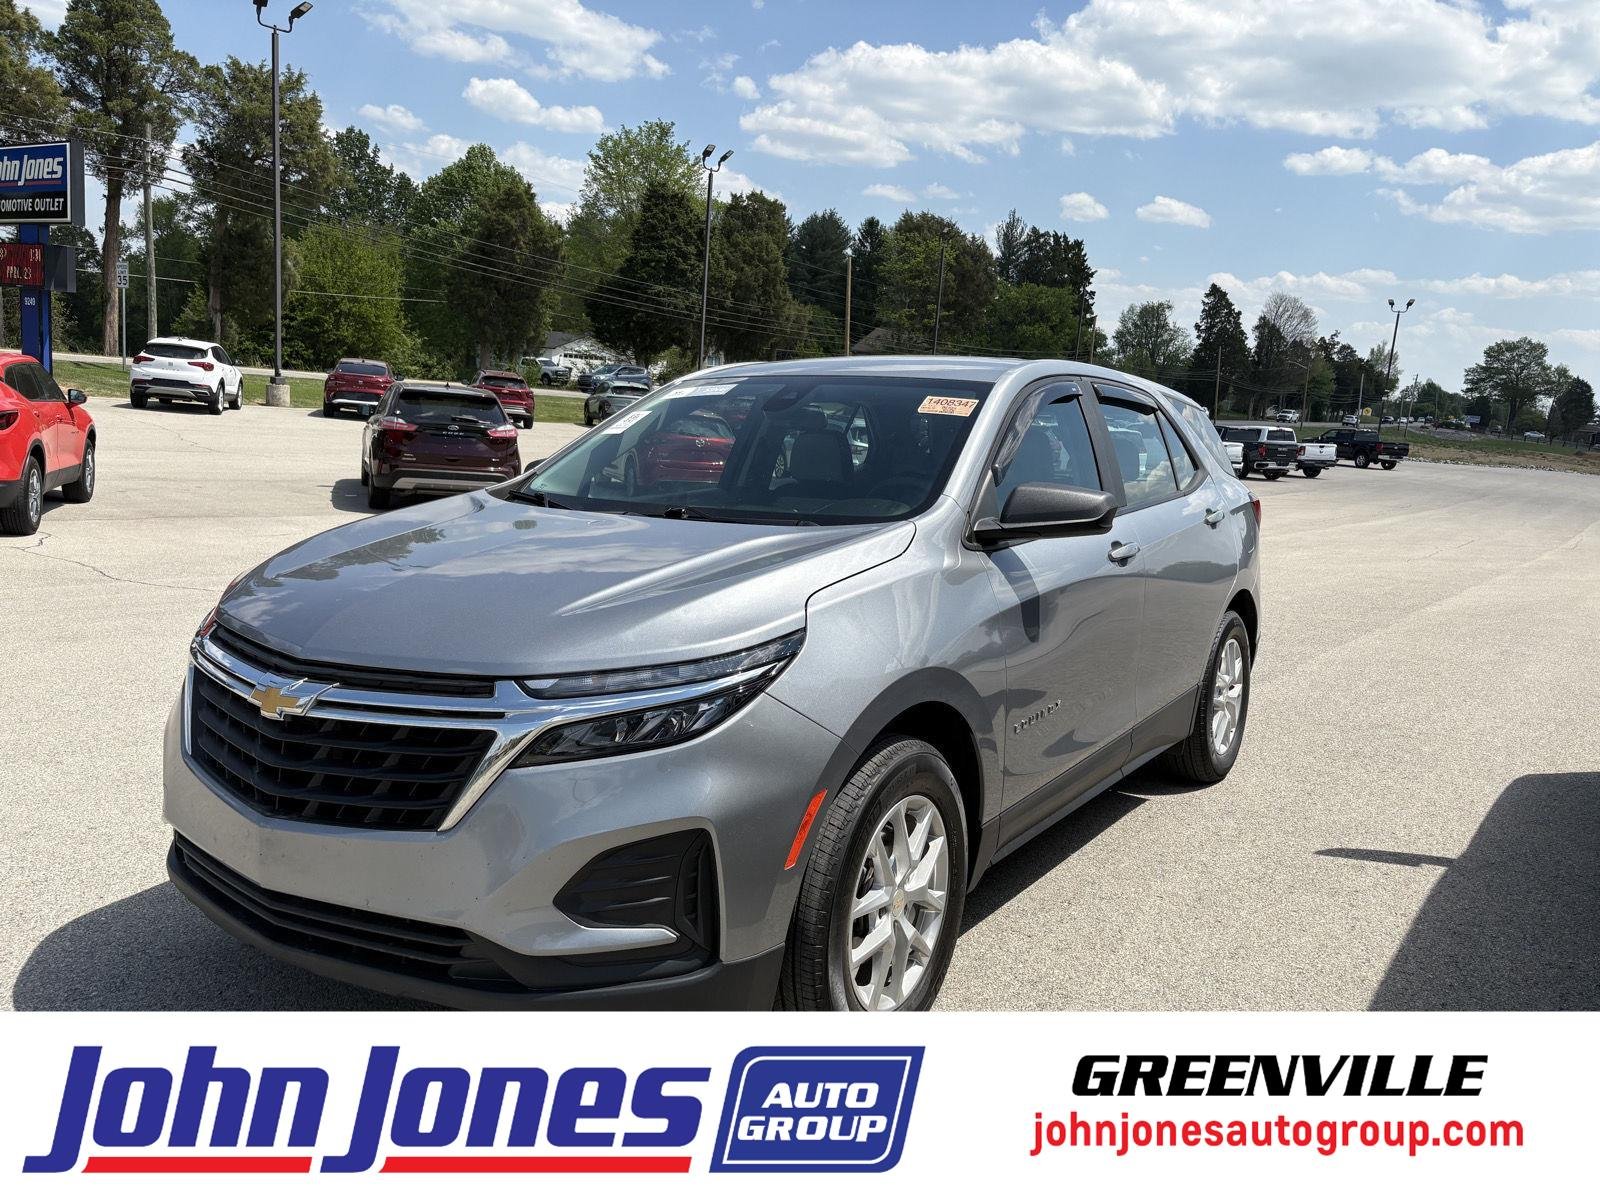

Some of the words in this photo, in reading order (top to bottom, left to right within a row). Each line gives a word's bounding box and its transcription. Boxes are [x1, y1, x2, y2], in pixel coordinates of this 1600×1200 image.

[18, 154, 64, 186] Jones
[0, 198, 33, 212] OMOTIVE
[34, 198, 64, 212] OUTLET
[117, 275, 128, 286] 35
[927, 398, 977, 409] 1408347
